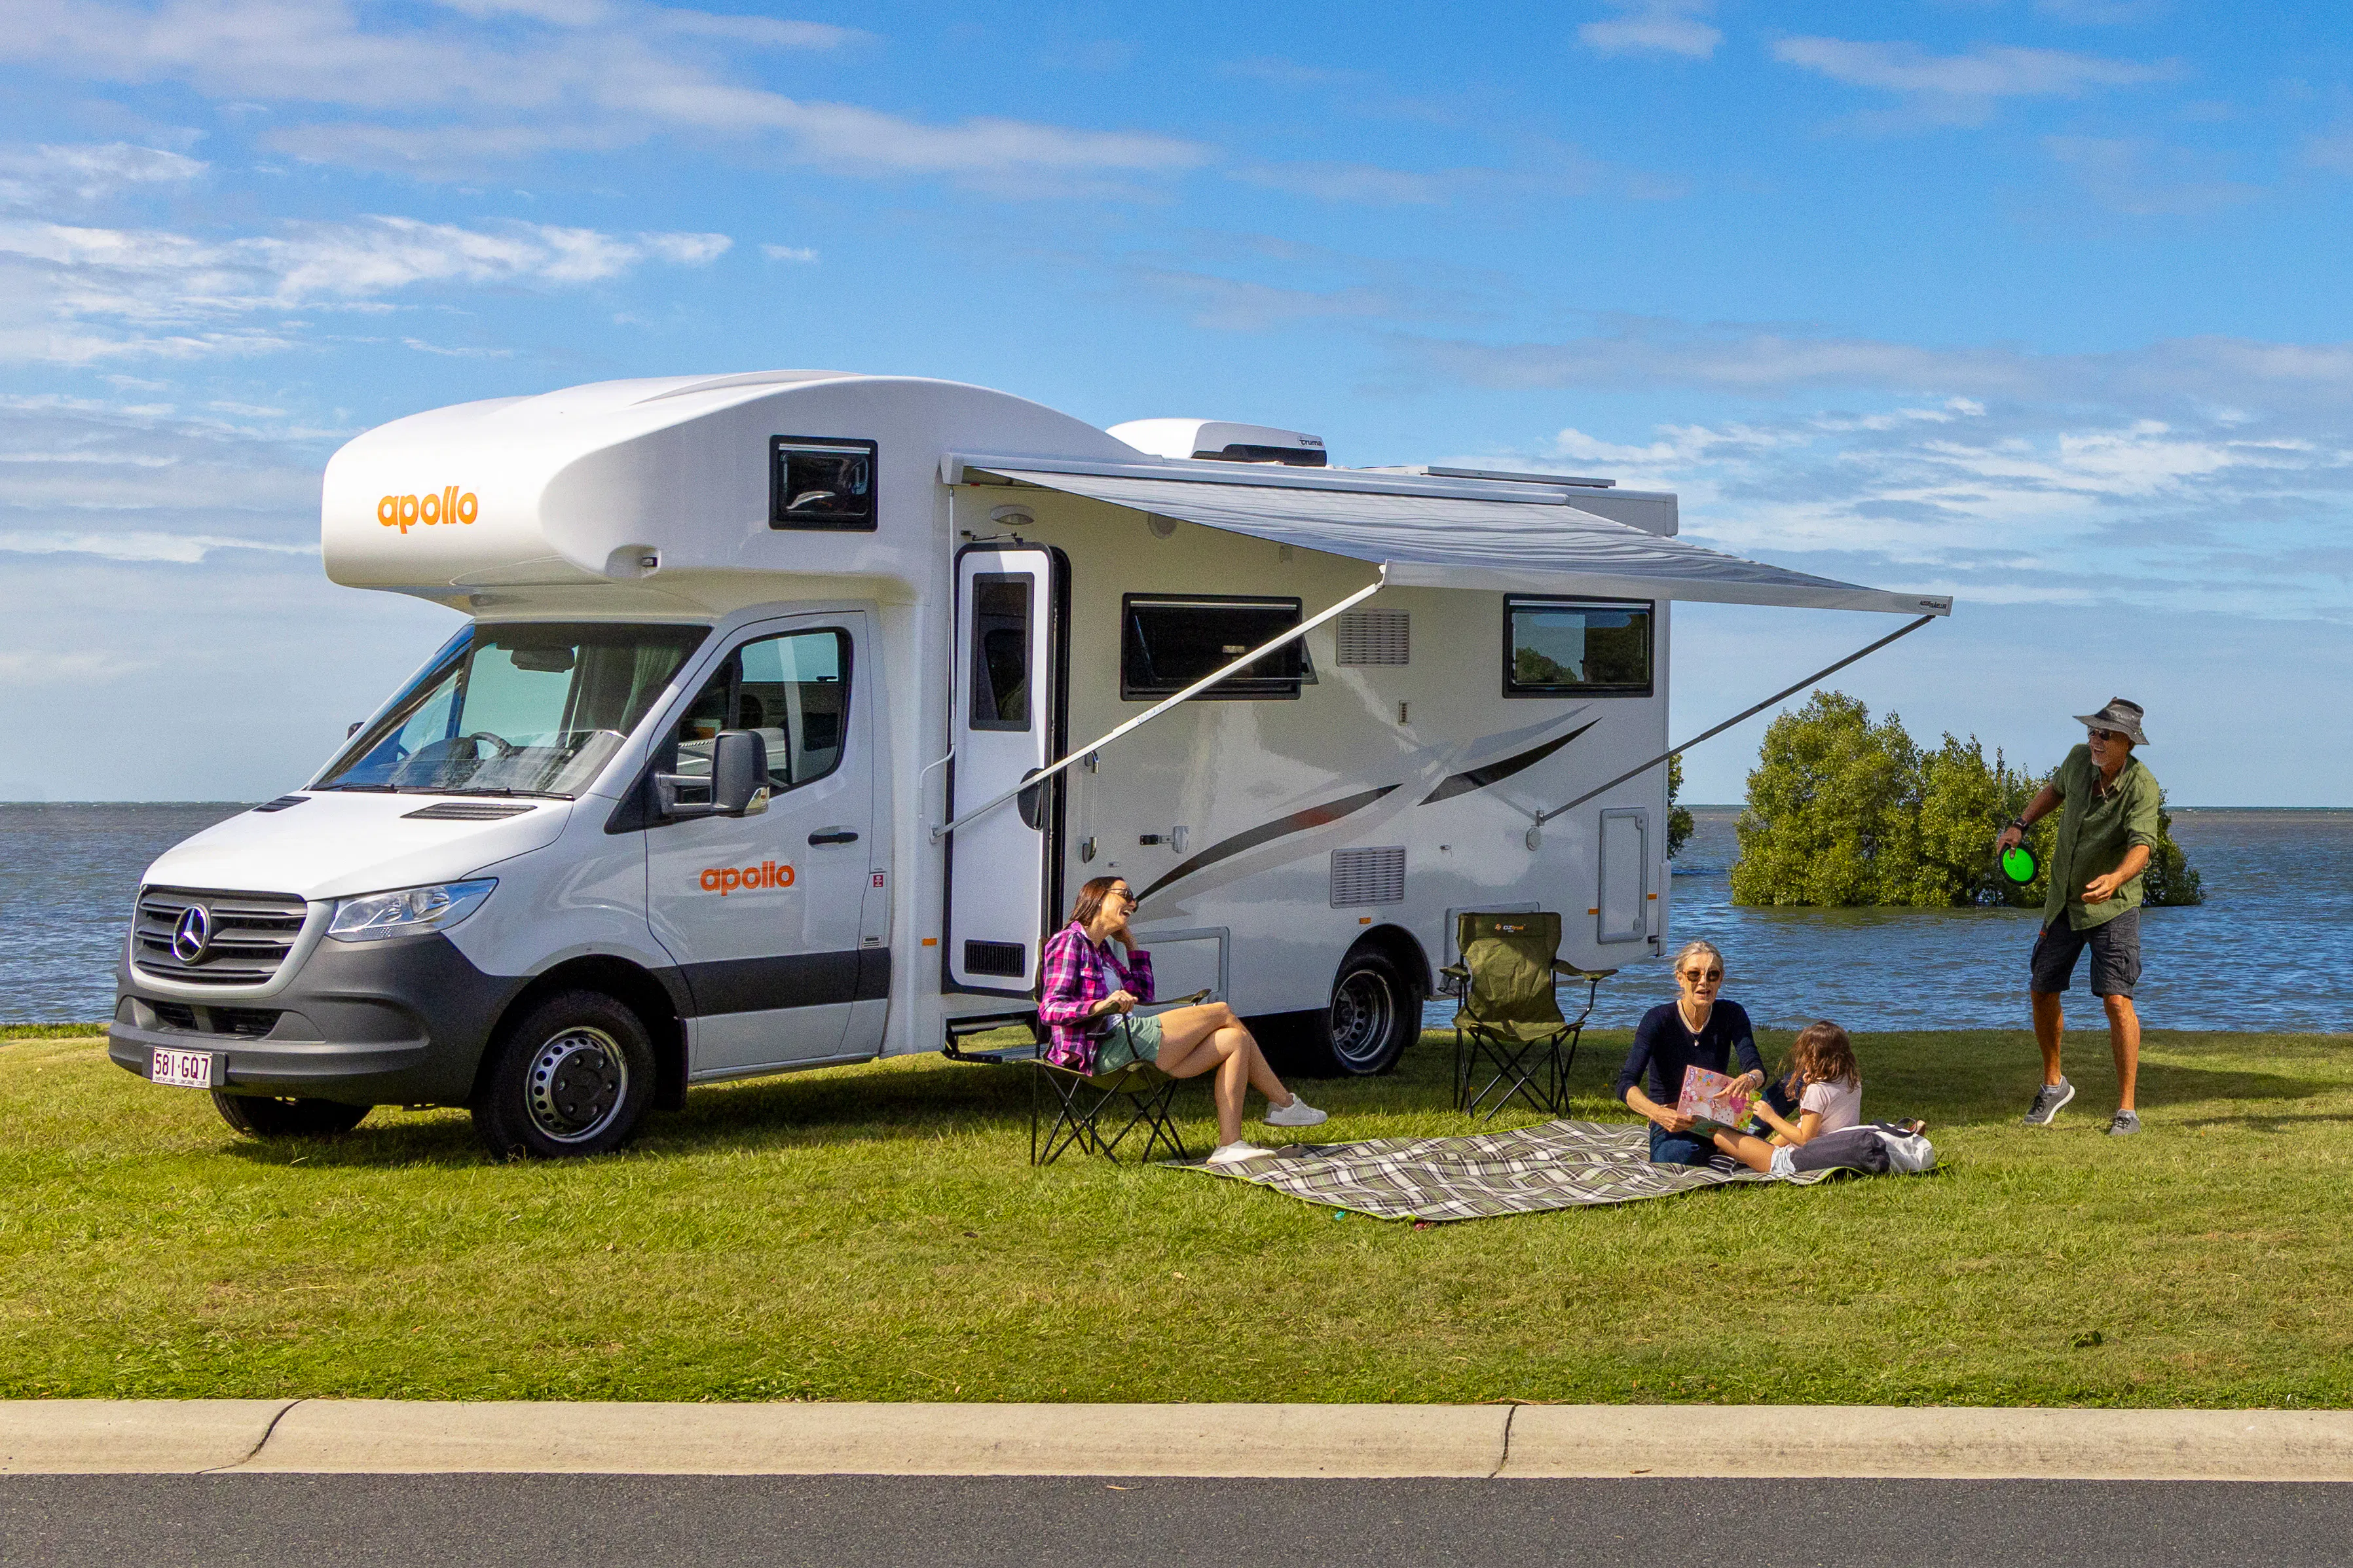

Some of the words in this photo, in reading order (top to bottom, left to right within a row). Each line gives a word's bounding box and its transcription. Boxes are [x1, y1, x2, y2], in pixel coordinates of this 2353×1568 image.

[1299, 437, 1323, 446] truma
[377, 485, 478, 534] apollo
[700, 860, 795, 896] apollo
